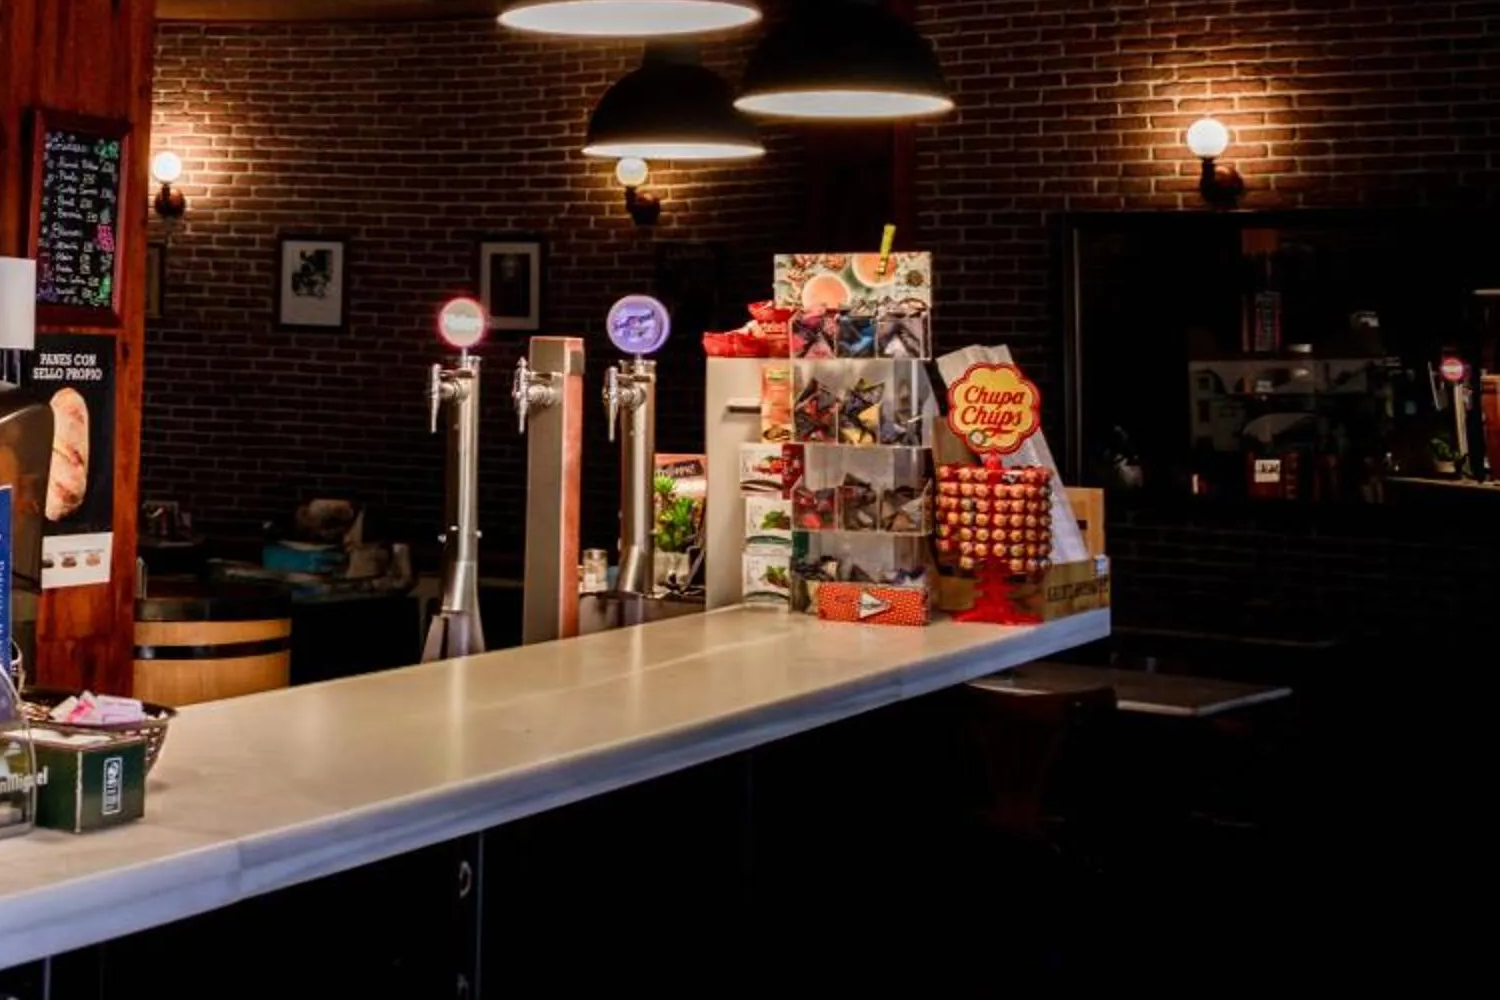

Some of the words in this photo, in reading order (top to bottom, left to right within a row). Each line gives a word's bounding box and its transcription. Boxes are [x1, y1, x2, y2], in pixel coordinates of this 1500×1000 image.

[39, 353, 72, 365] PANES
[73, 354, 97, 366] CON
[32, 367, 64, 379] SELLO
[65, 368, 103, 381] PROPIO
[964, 384, 1025, 411] Chupa
[961, 404, 1023, 430] Chups
